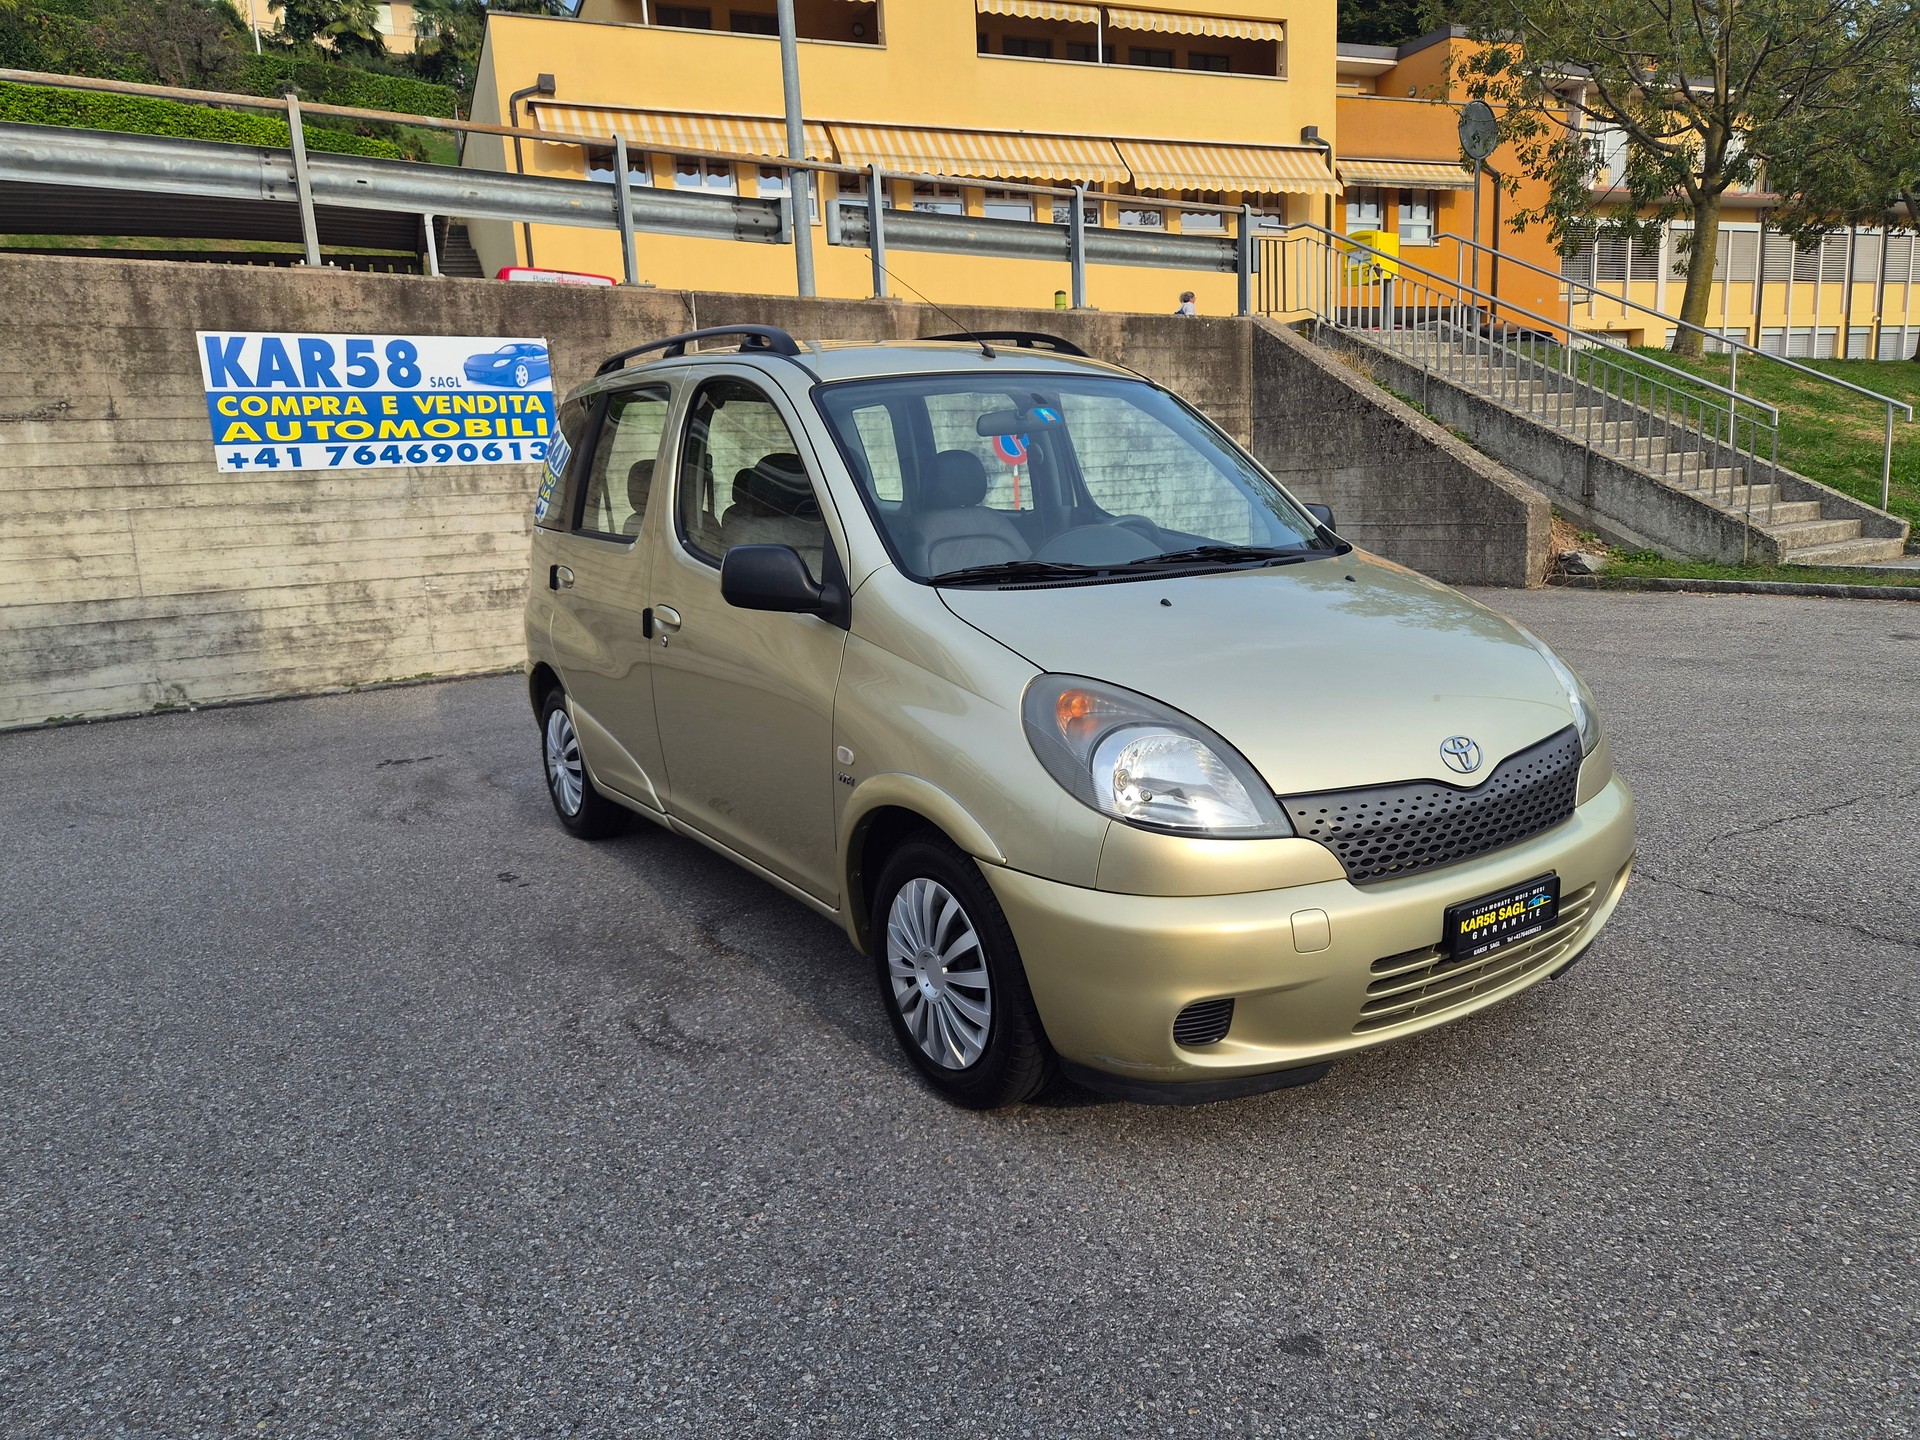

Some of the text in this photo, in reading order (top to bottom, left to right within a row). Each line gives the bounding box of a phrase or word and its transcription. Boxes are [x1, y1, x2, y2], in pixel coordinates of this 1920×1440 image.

[204, 336, 462, 388] KAR58 SAGL
[217, 394, 546, 417] COMPRA E VENDITA
[221, 418, 549, 442] AUTOMOBILI
[227, 441, 549, 469] +41 764690613
[1472, 906, 1488, 916] 12/24
[1488, 898, 1511, 910] MONATE
[1515, 892, 1528, 901] MOIS
[1532, 886, 1545, 895] MESI
[1460, 901, 1526, 934] KAR58 SAGL
[1472, 908, 1541, 940] GARANTIE
